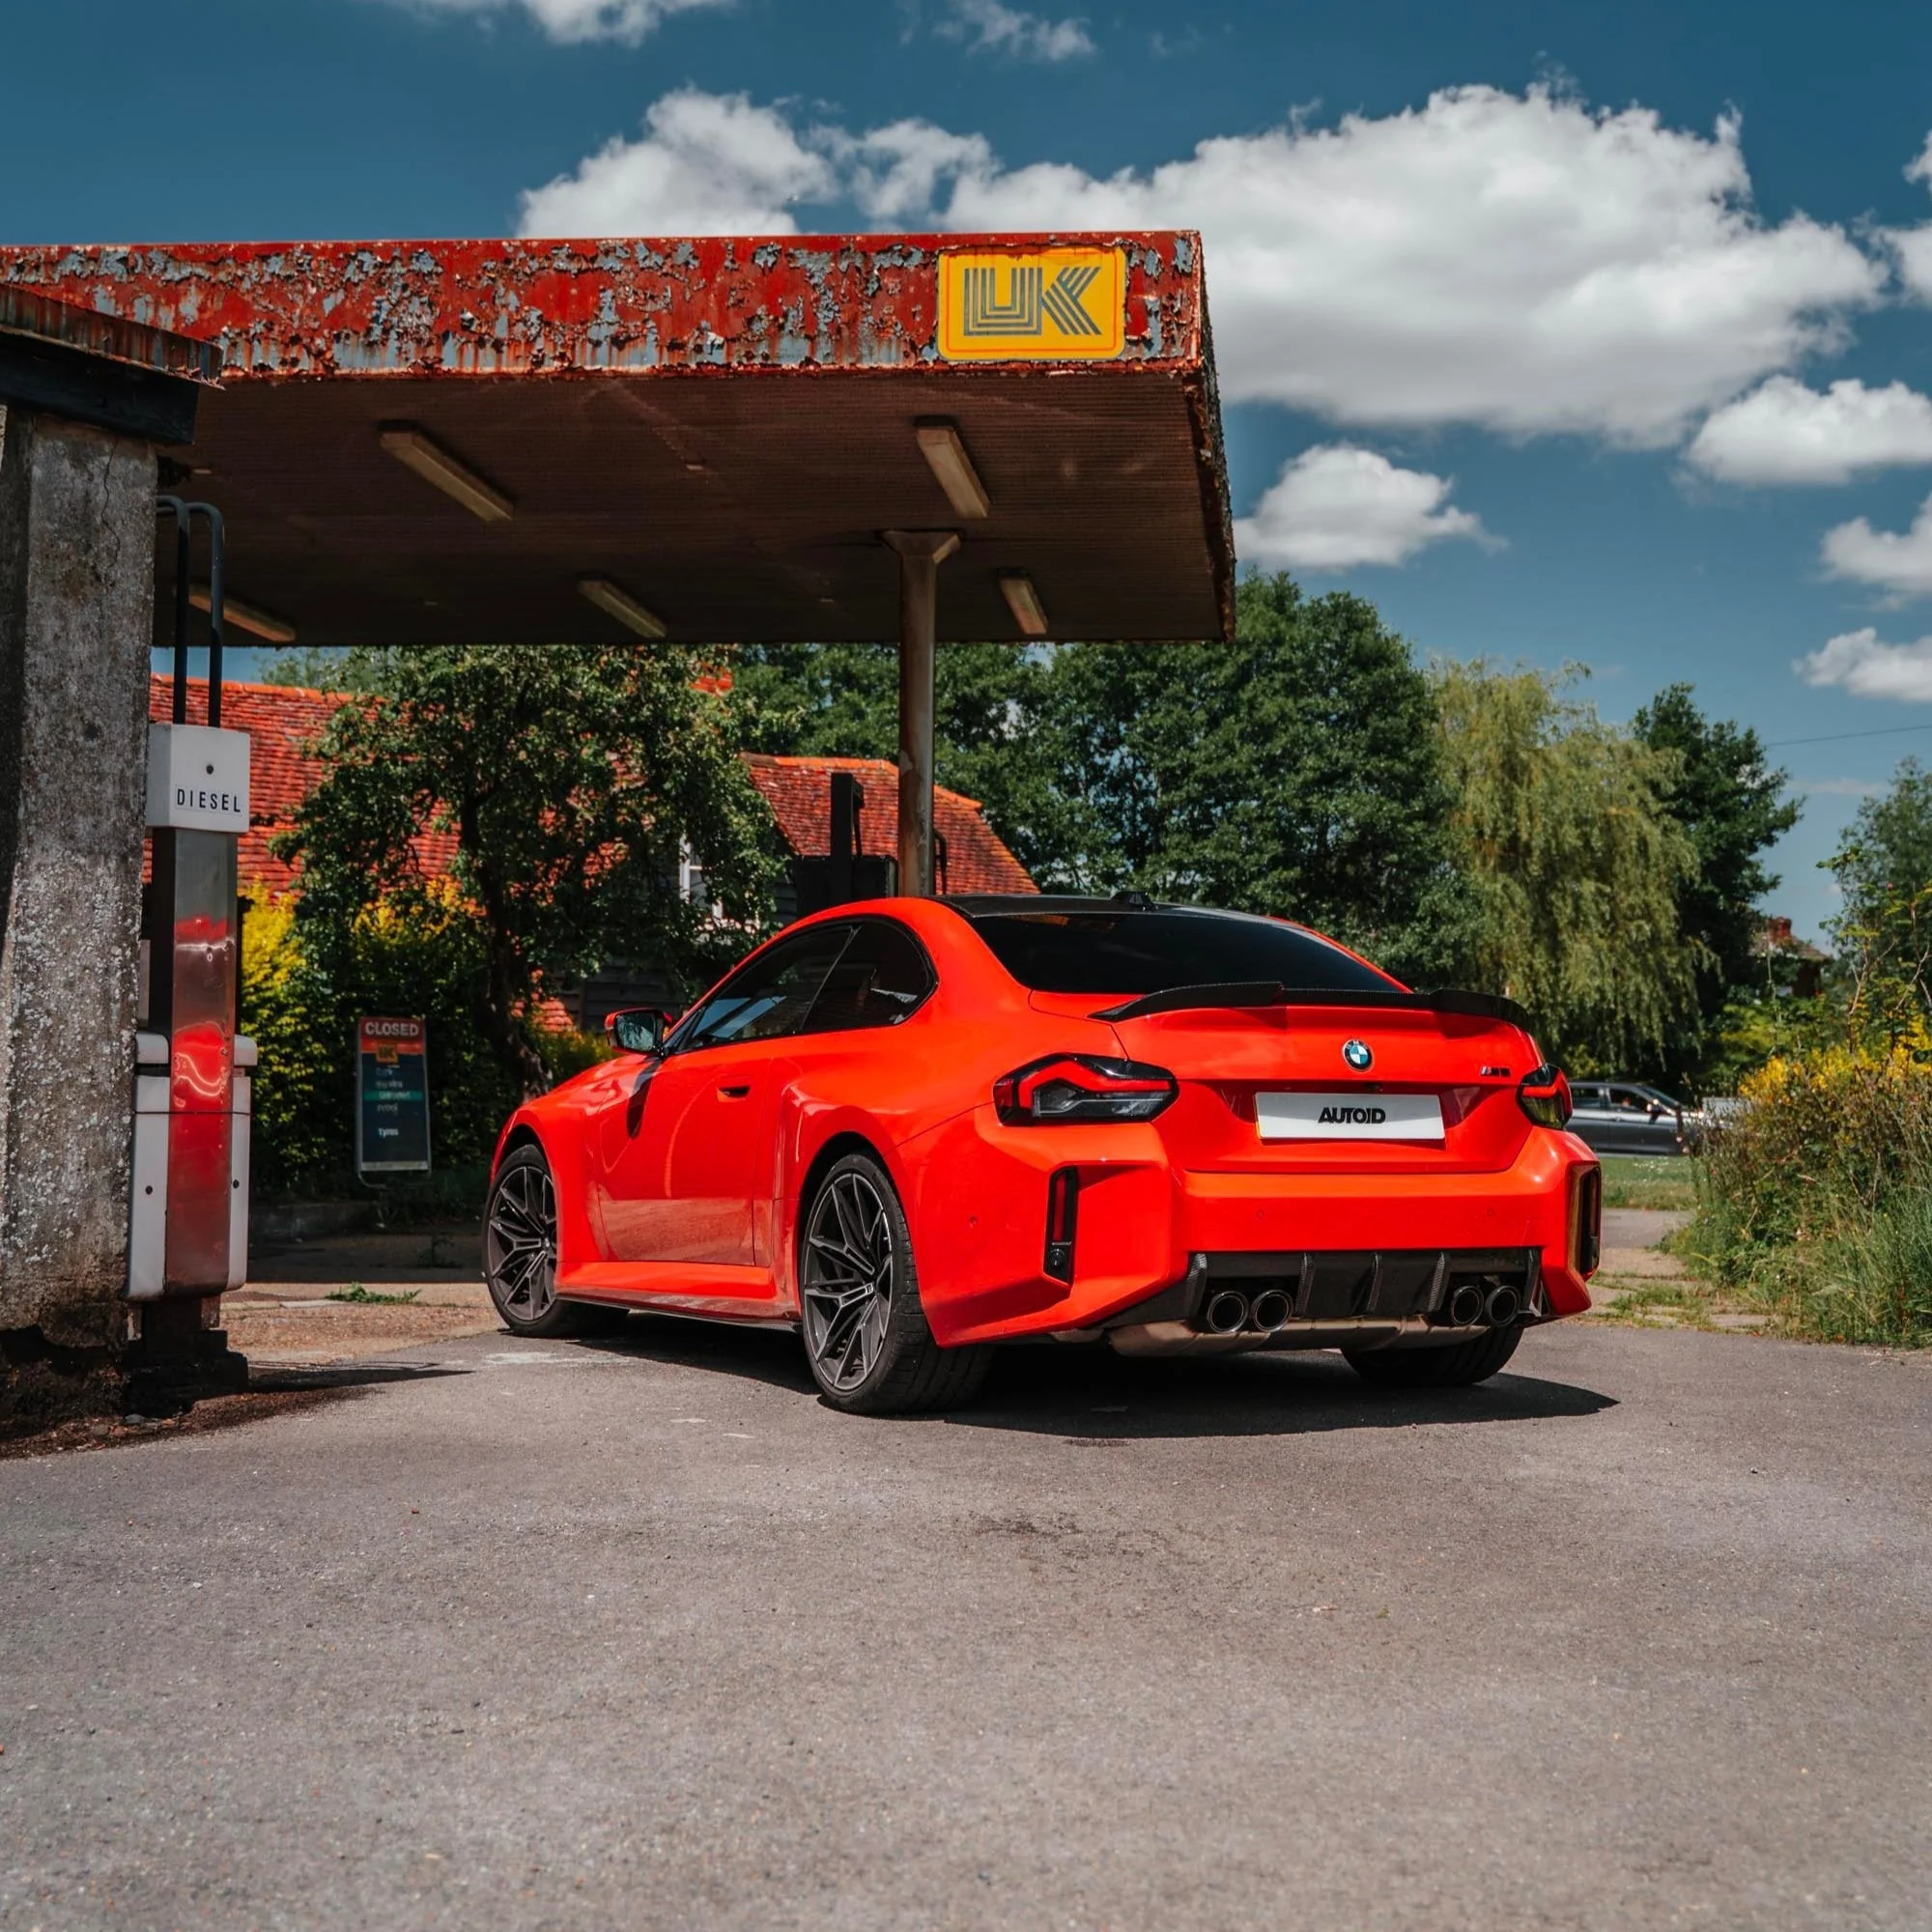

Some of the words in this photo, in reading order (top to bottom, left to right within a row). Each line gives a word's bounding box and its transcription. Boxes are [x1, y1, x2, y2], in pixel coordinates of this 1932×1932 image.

[963, 267, 1102, 336] UK
[177, 788, 242, 813] DIESEL
[365, 1021, 419, 1037] CLOSED
[1318, 1107, 1386, 1124] AUTOID
